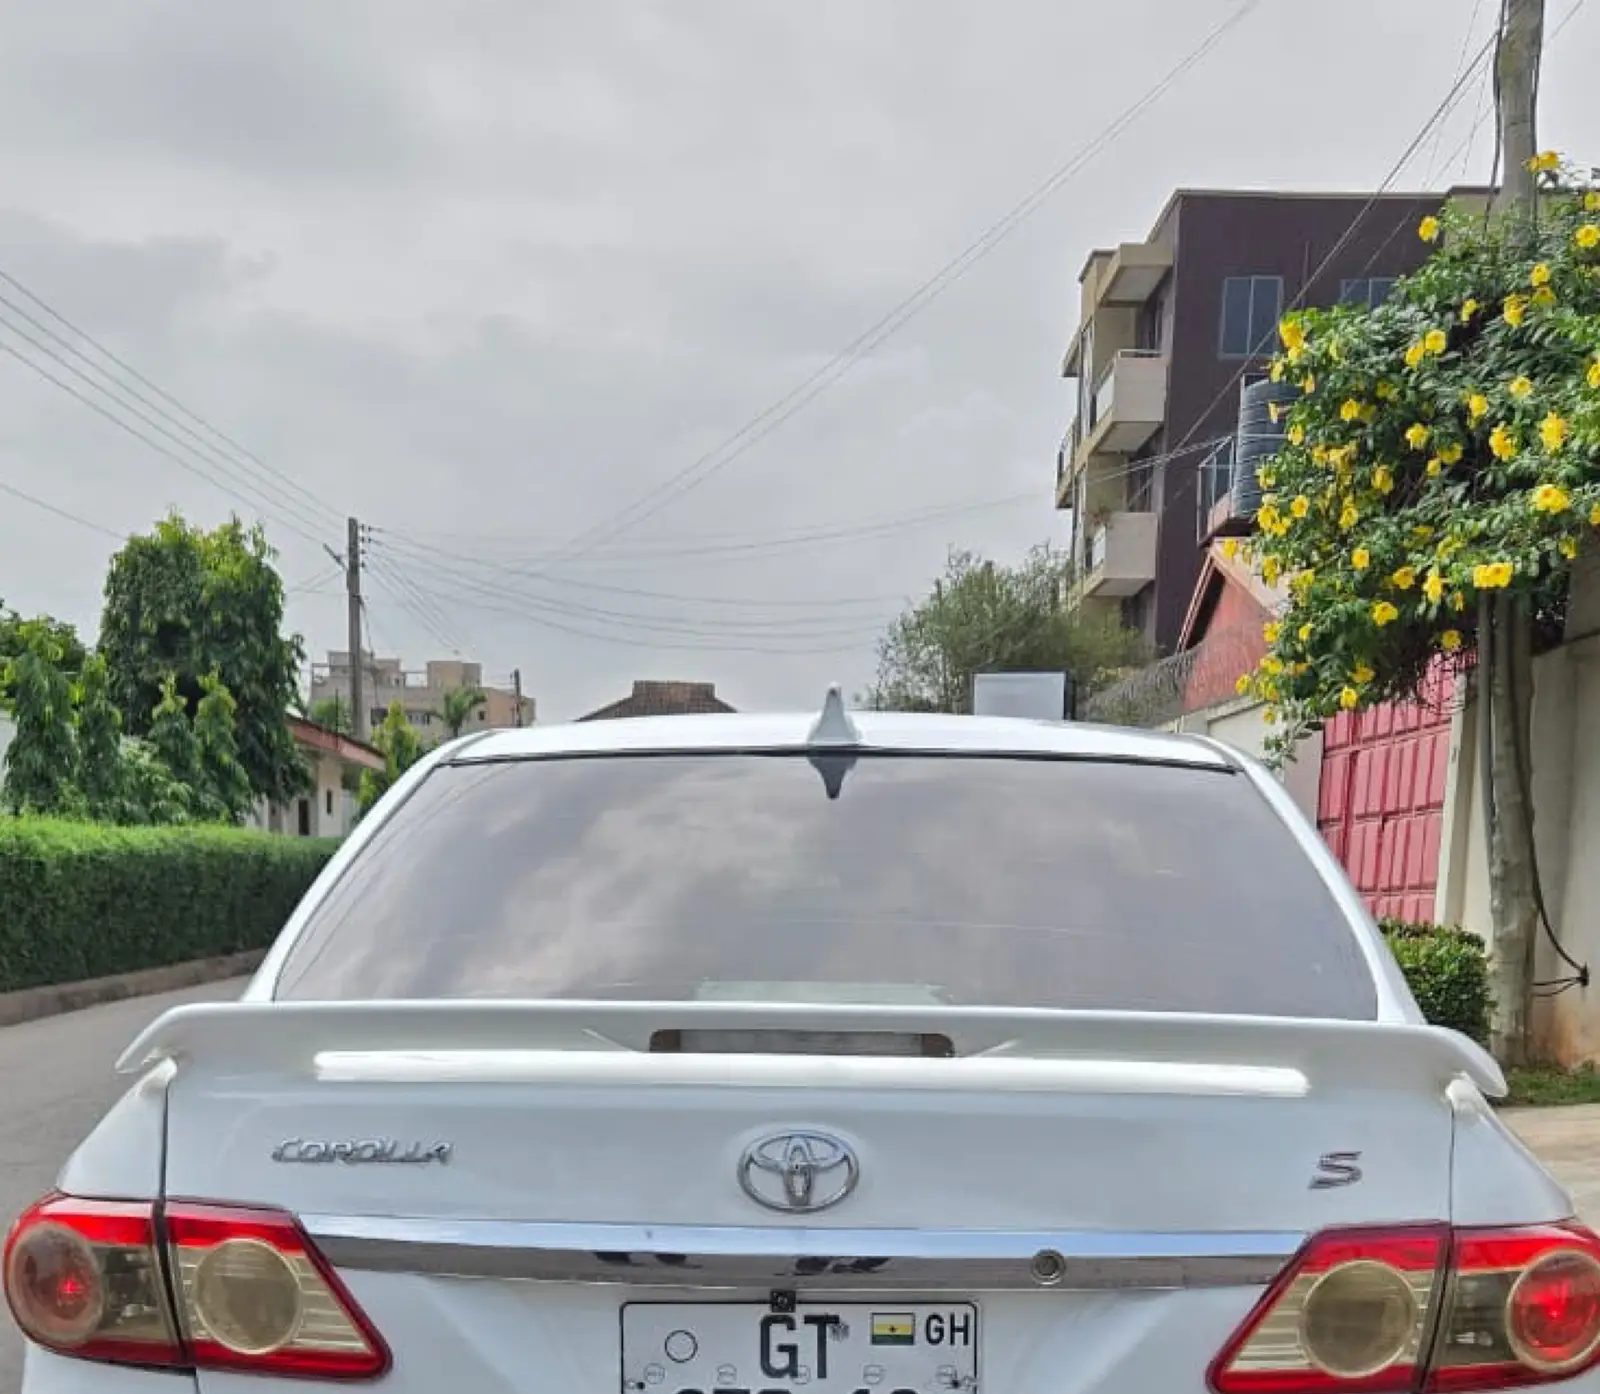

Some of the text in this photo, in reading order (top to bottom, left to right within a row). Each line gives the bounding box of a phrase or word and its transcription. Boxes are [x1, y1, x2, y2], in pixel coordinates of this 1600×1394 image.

[1308, 1151, 1362, 1189] S
[759, 1313, 841, 1379] GT
[924, 1312, 970, 1346] GH
